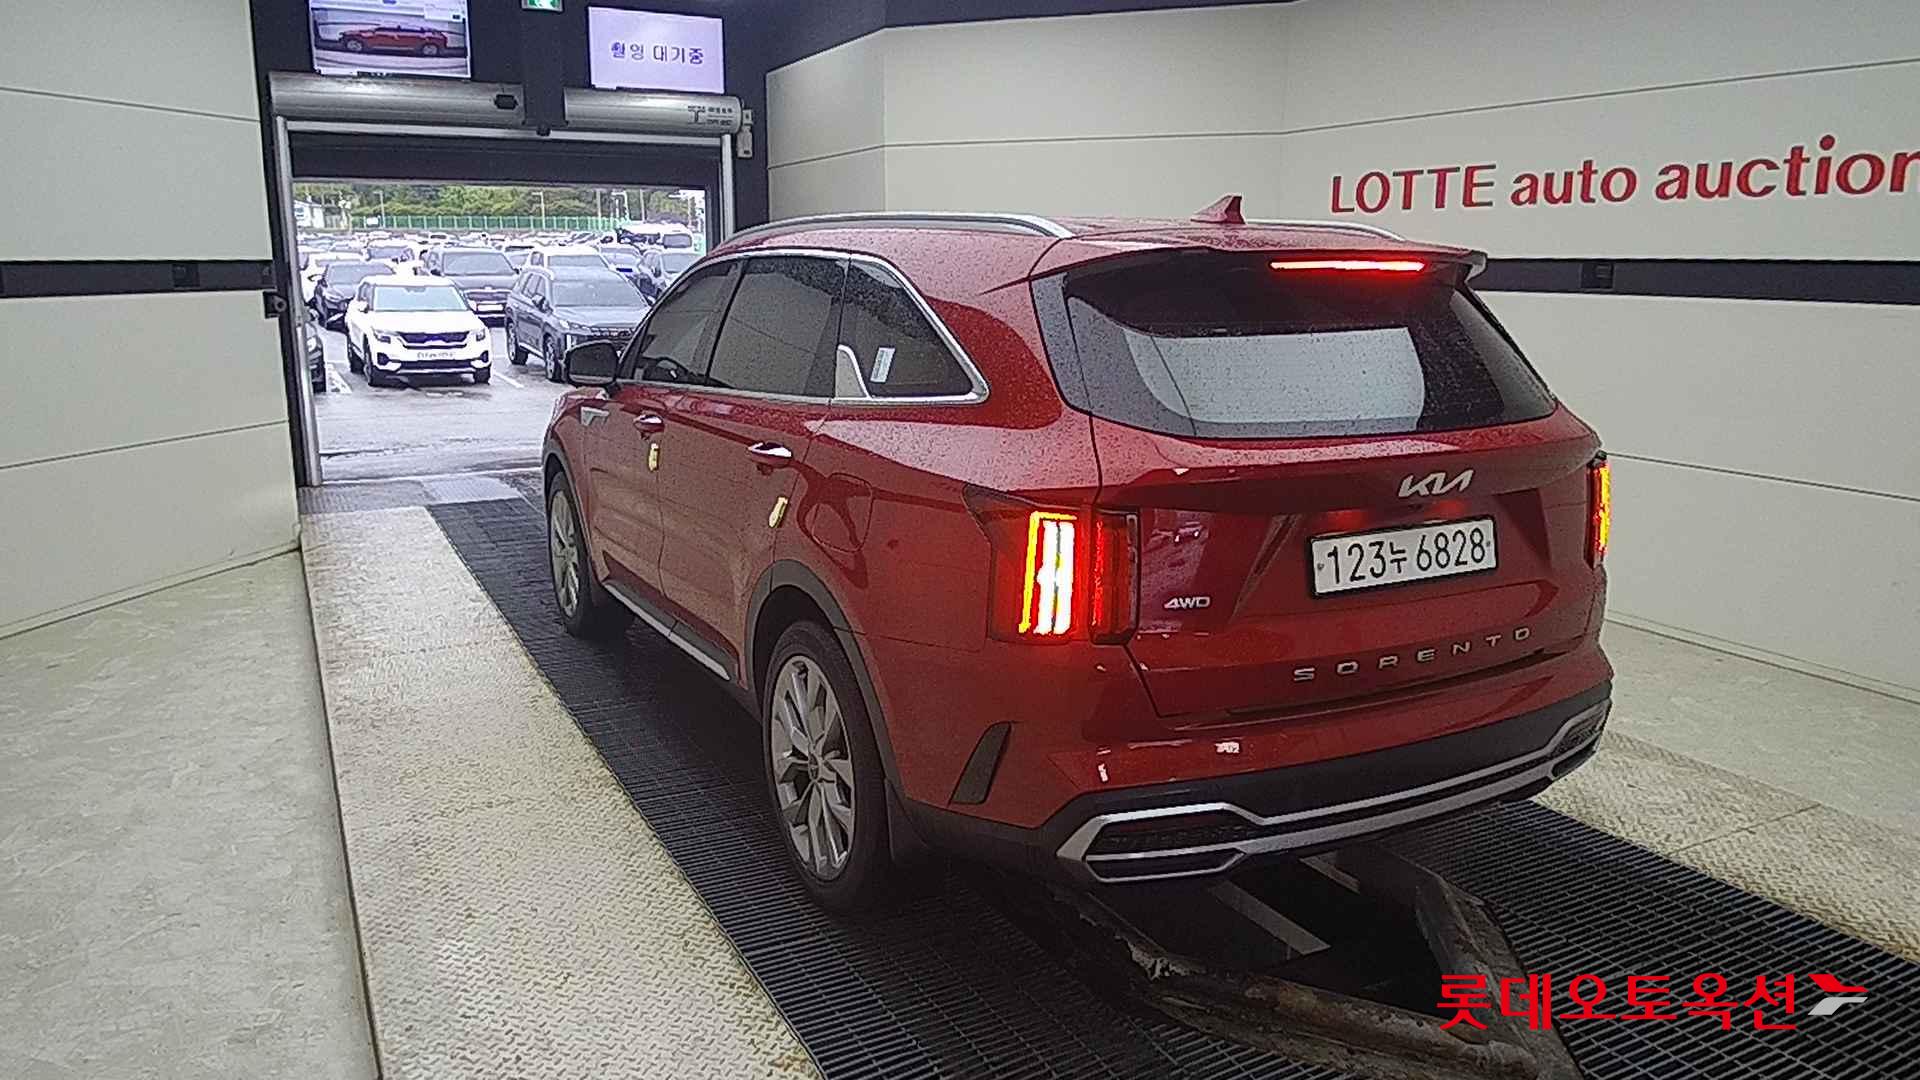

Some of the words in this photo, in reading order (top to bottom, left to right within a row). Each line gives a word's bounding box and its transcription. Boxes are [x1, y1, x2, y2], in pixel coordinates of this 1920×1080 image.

[653, 44, 704, 65] 대기중
[1331, 164, 1497, 213] LOTTE
[1510, 159, 1637, 206] auto
[1164, 596, 1210, 609] 4WD
[1294, 627, 1531, 682] SORENTO
